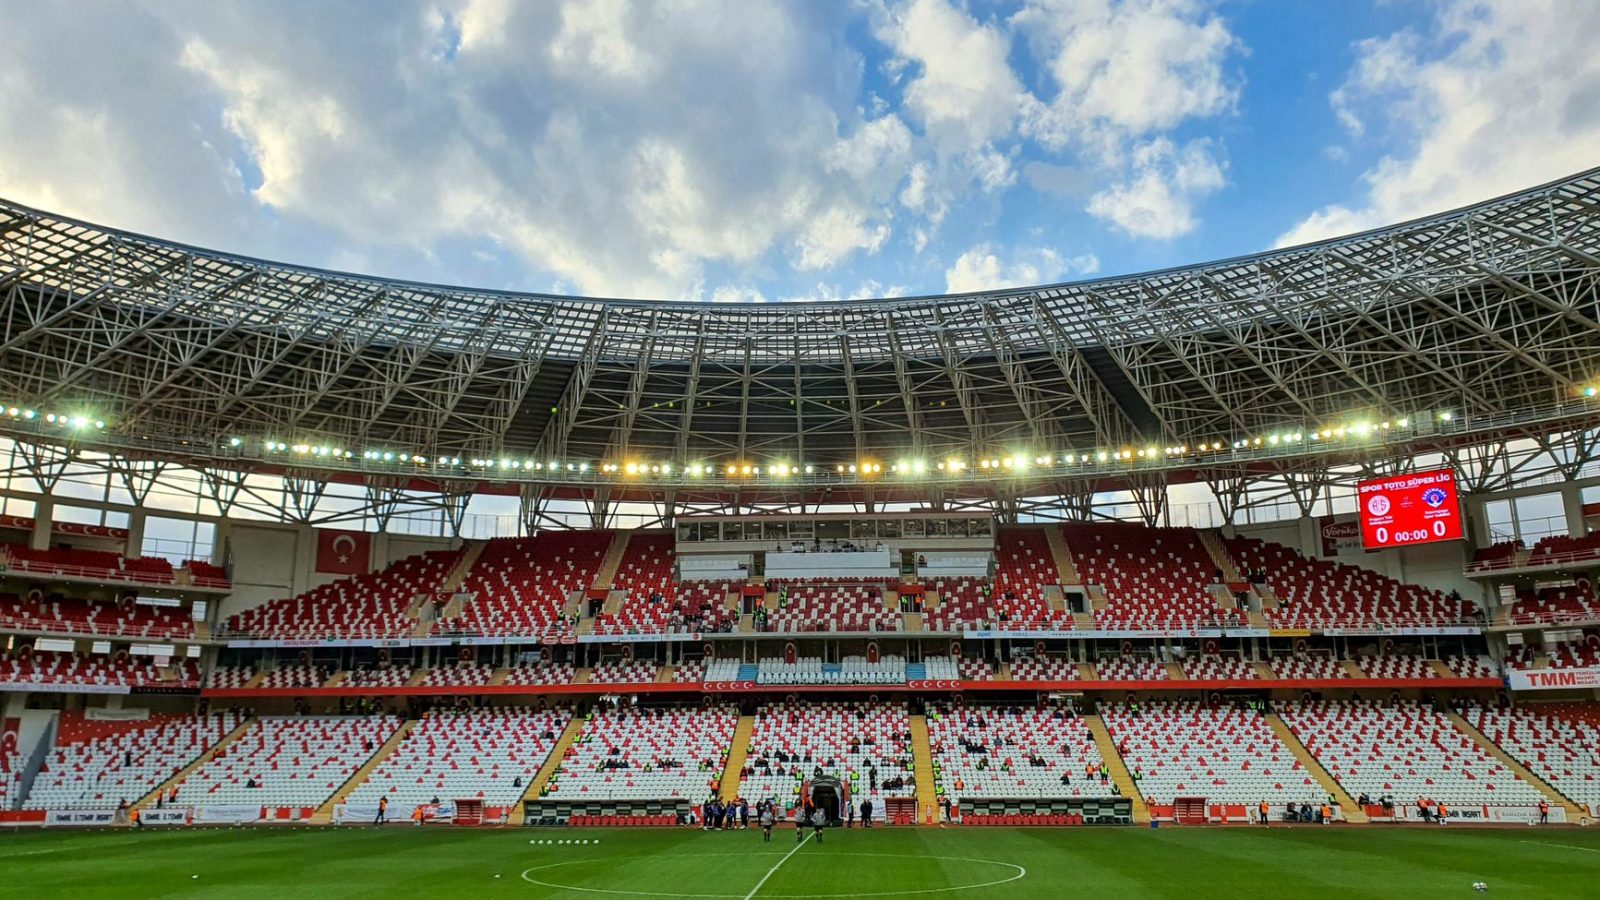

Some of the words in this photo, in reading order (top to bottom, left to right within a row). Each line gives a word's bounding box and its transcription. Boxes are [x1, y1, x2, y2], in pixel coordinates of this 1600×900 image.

[1360, 485, 1382, 493] SPOR
[1383, 481, 1406, 490] TOTO
[1376, 527, 1388, 543] 0
[1395, 529, 1428, 542] 00:00
[1433, 520, 1446, 537] 0
[1526, 672, 1576, 686] TMM
